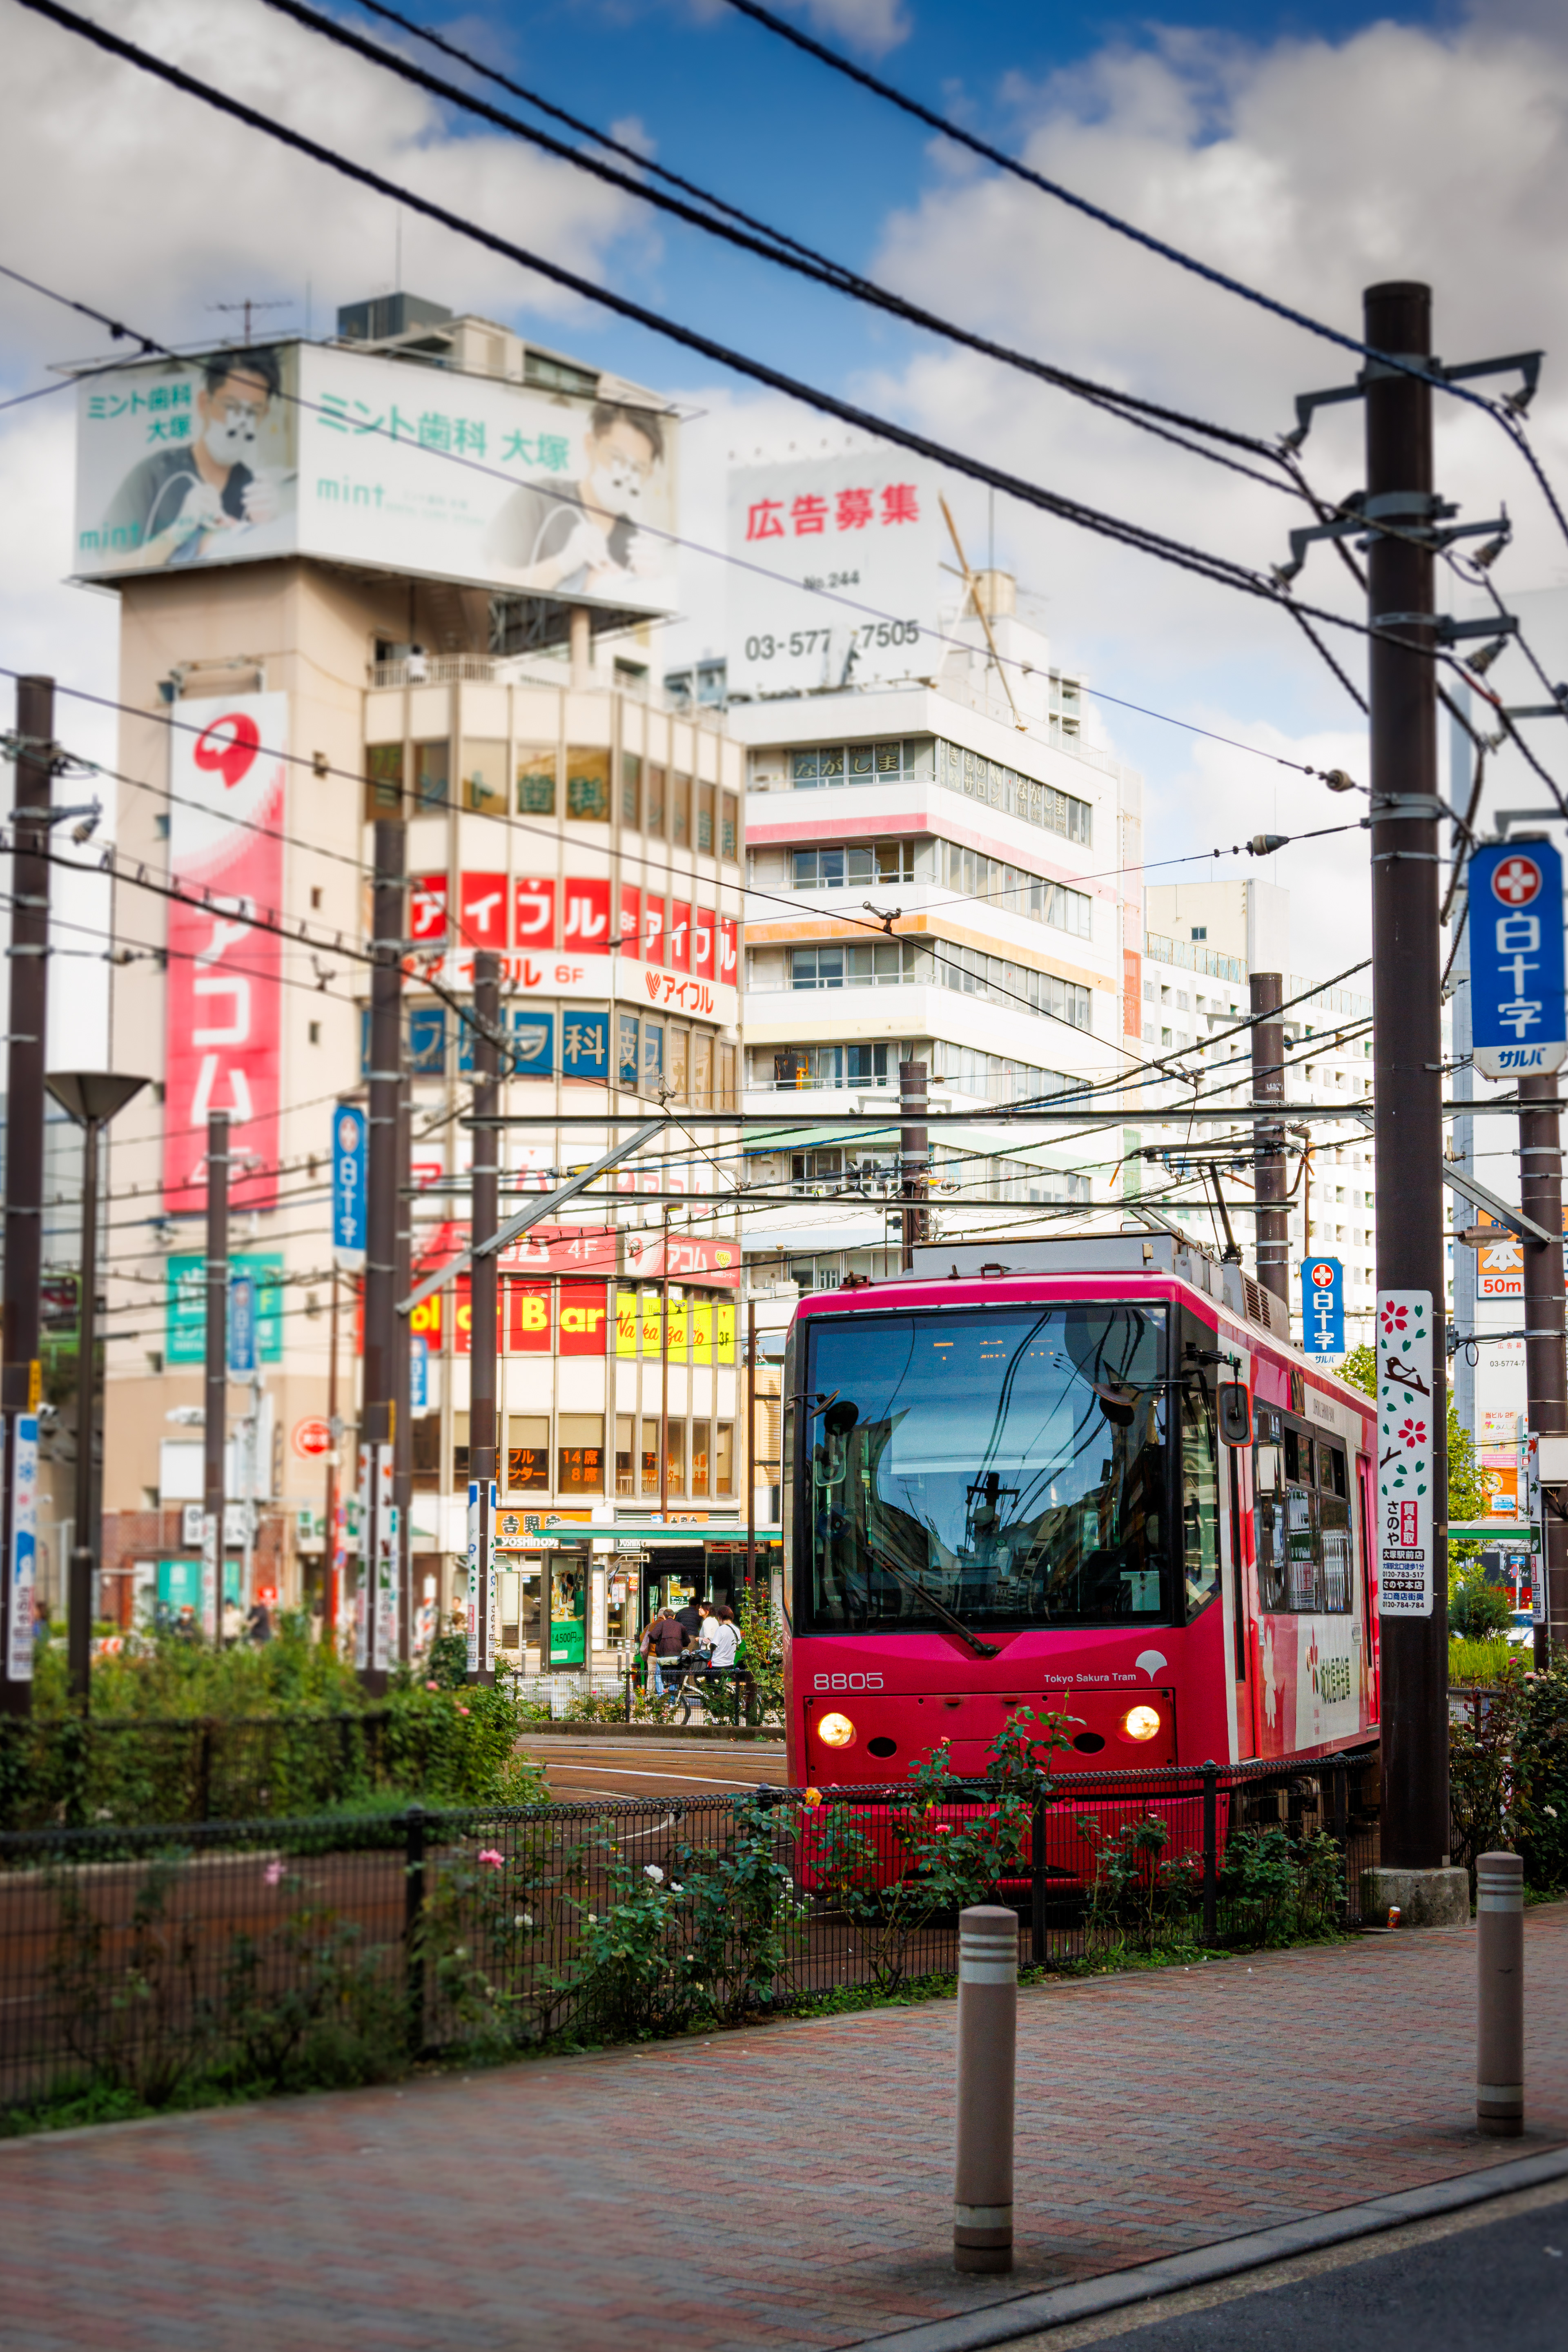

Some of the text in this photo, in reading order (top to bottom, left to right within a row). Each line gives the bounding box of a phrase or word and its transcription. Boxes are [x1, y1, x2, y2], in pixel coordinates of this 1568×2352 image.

[88, 382, 192, 419] ミント歯科
[147, 414, 191, 443] 大塚
[318, 394, 570, 471] ミント歯科 大塚
[317, 475, 385, 508] mint
[745, 483, 920, 541] 広告募集
[80, 522, 140, 550] mint
[796, 754, 898, 777] ながしま
[1016, 777, 1065, 816] ながしま
[1016, 801, 1027, 816] TEL
[412, 890, 607, 938] アイフル
[646, 910, 737, 971] アイフル
[554, 964, 584, 984] 6F
[1495, 911, 1542, 1038] 白十字
[192, 894, 257, 1126] アコム
[662, 976, 713, 1014] アイフル
[1498, 1047, 1546, 1068] サルバ
[568, 1239, 598, 1260] 4F
[668, 1244, 706, 1274] アコム
[522, 1297, 604, 1332] Bar
[1314, 1290, 1334, 1350] 白十字
[719, 1331, 729, 1346] 3F
[1314, 1355, 1336, 1363] サルバ
[1387, 1501, 1400, 1546] さのや
[1383, 1550, 1423, 1560] 大塚駅前店
[1383, 1581, 1423, 1590] さのや本店
[813, 1673, 884, 1690] 8805
[1044, 1673, 1136, 1684] Tokyo Sakura Tram
